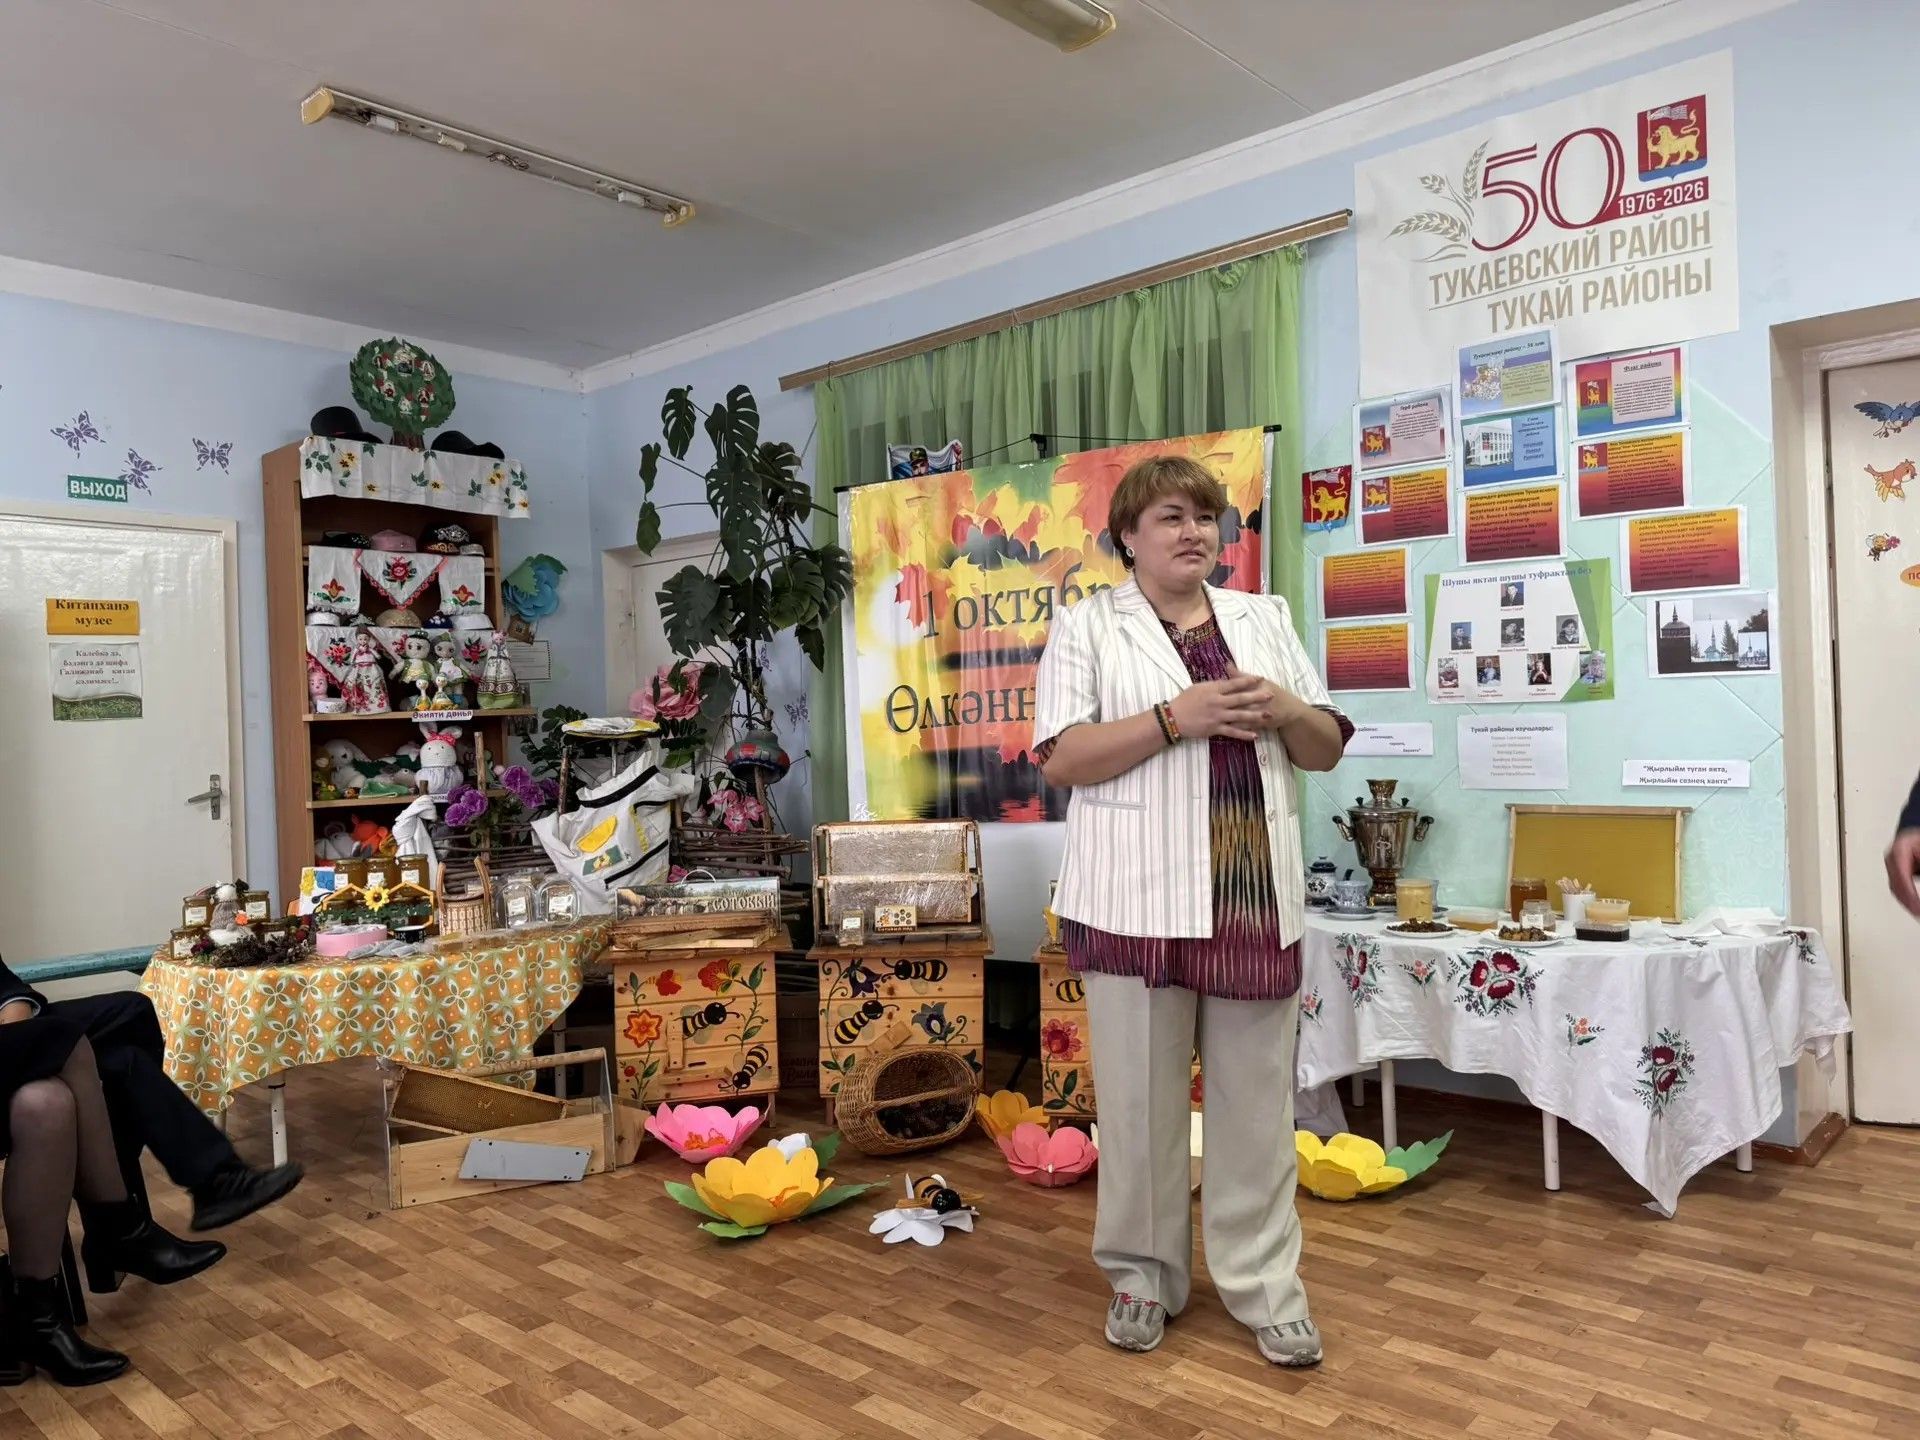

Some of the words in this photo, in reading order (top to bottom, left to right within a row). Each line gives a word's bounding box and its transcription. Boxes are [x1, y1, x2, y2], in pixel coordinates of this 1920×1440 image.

[1471, 126, 1625, 252] 50
[1617, 180, 1704, 216] 1976-2026
[1428, 228, 1600, 305] ТУКАЕВСКИЙ
[1609, 210, 1711, 262] РАЙОН
[1487, 277, 1573, 333] ТУКАЙ
[1582, 258, 1712, 313] РАЙОНЫ
[70, 480, 126, 500] ВЫХОД
[1442, 578, 1471, 588] Шушы
[55, 599, 130, 611] Китапханә
[922, 590, 940, 639] 1
[75, 617, 113, 627] музее
[413, 711, 444, 719] Әкияти
[446, 710, 472, 719] дөнья
